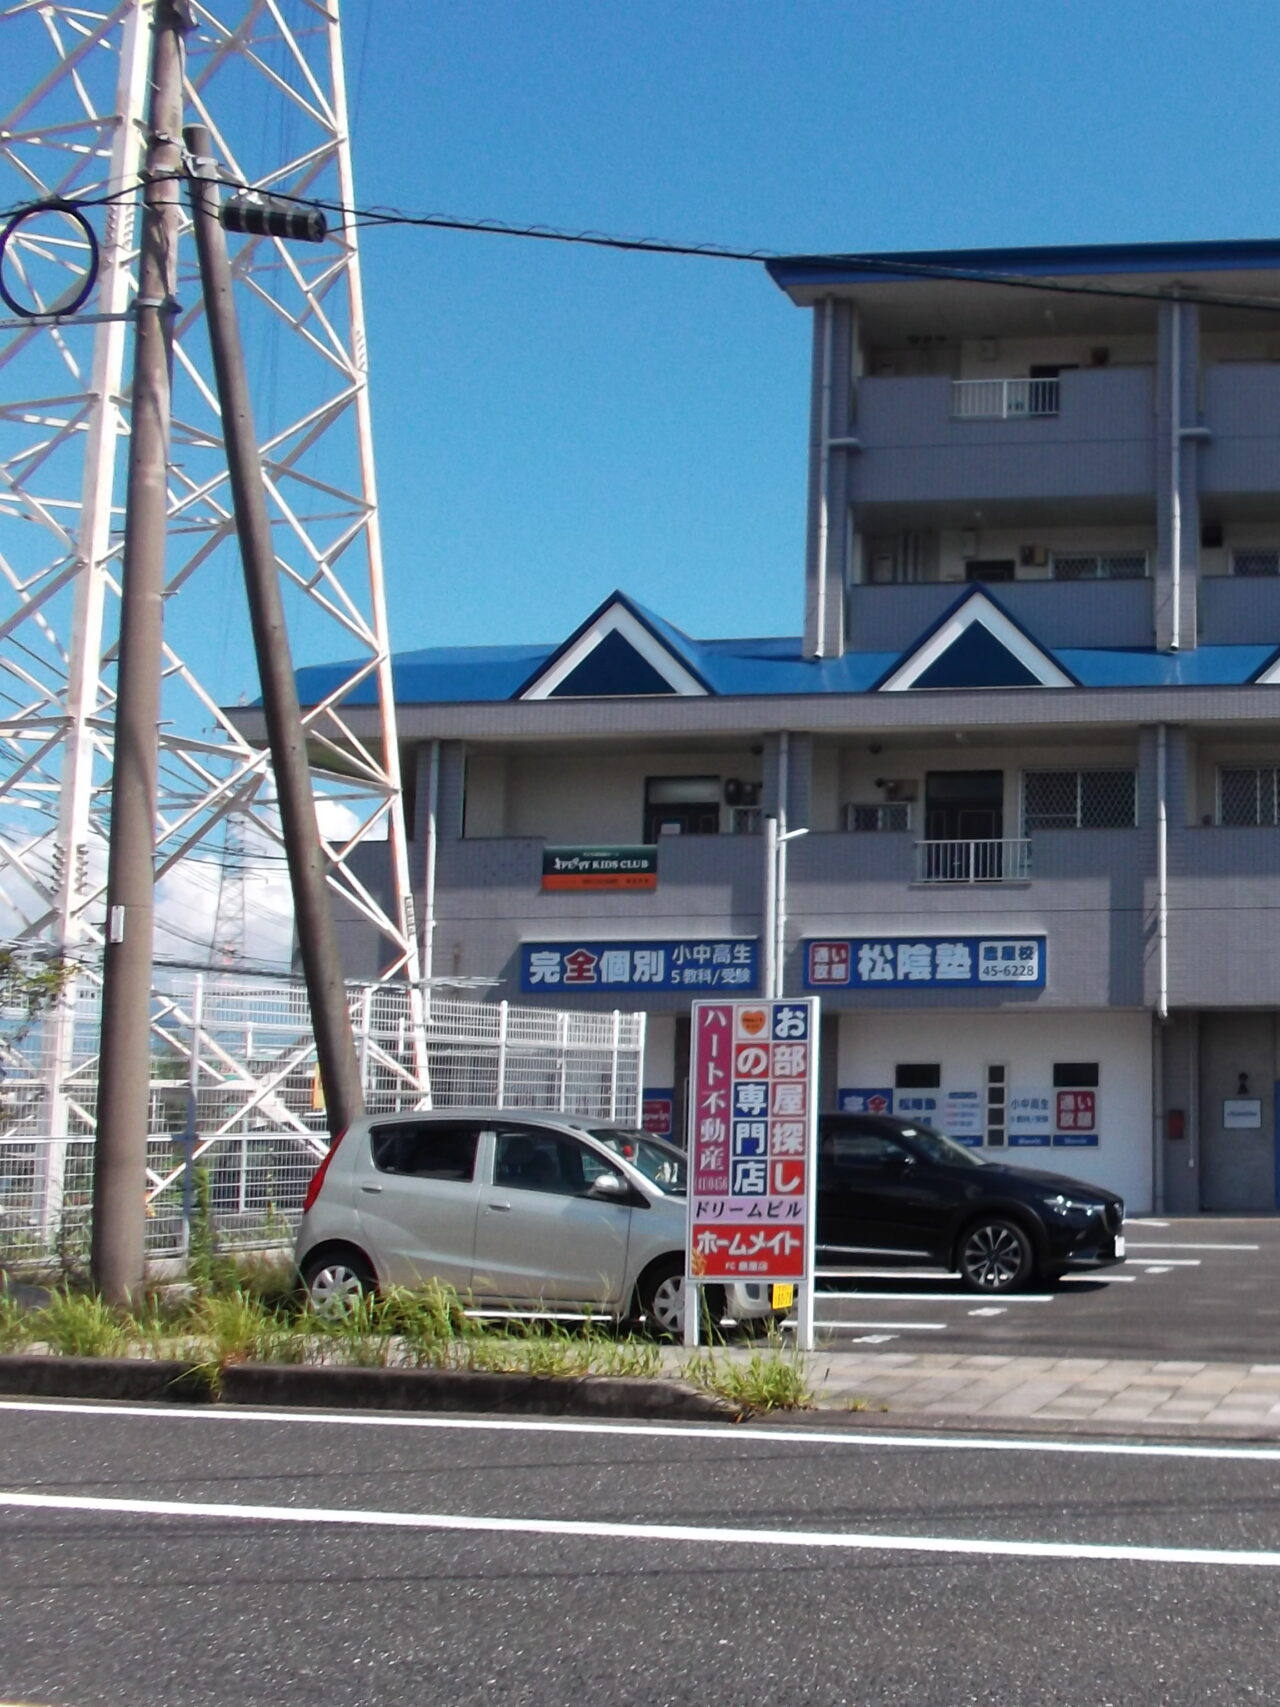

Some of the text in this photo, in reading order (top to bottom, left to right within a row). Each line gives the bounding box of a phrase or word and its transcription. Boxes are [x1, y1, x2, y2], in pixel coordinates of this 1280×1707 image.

[592, 859, 619, 869] KIDS
[620, 859, 649, 869] CLUB
[529, 948, 665, 984] 完全個別
[672, 944, 752, 965] 小中高生
[982, 965, 1035, 977] 45-6228
[699, 1008, 726, 1172] ハート不動産
[771, 1006, 807, 1193] お部屋探し
[733, 1046, 768, 1194] の専門店
[696, 1201, 802, 1220] ドリームビル
[697, 1230, 800, 1257] ホームメイト
